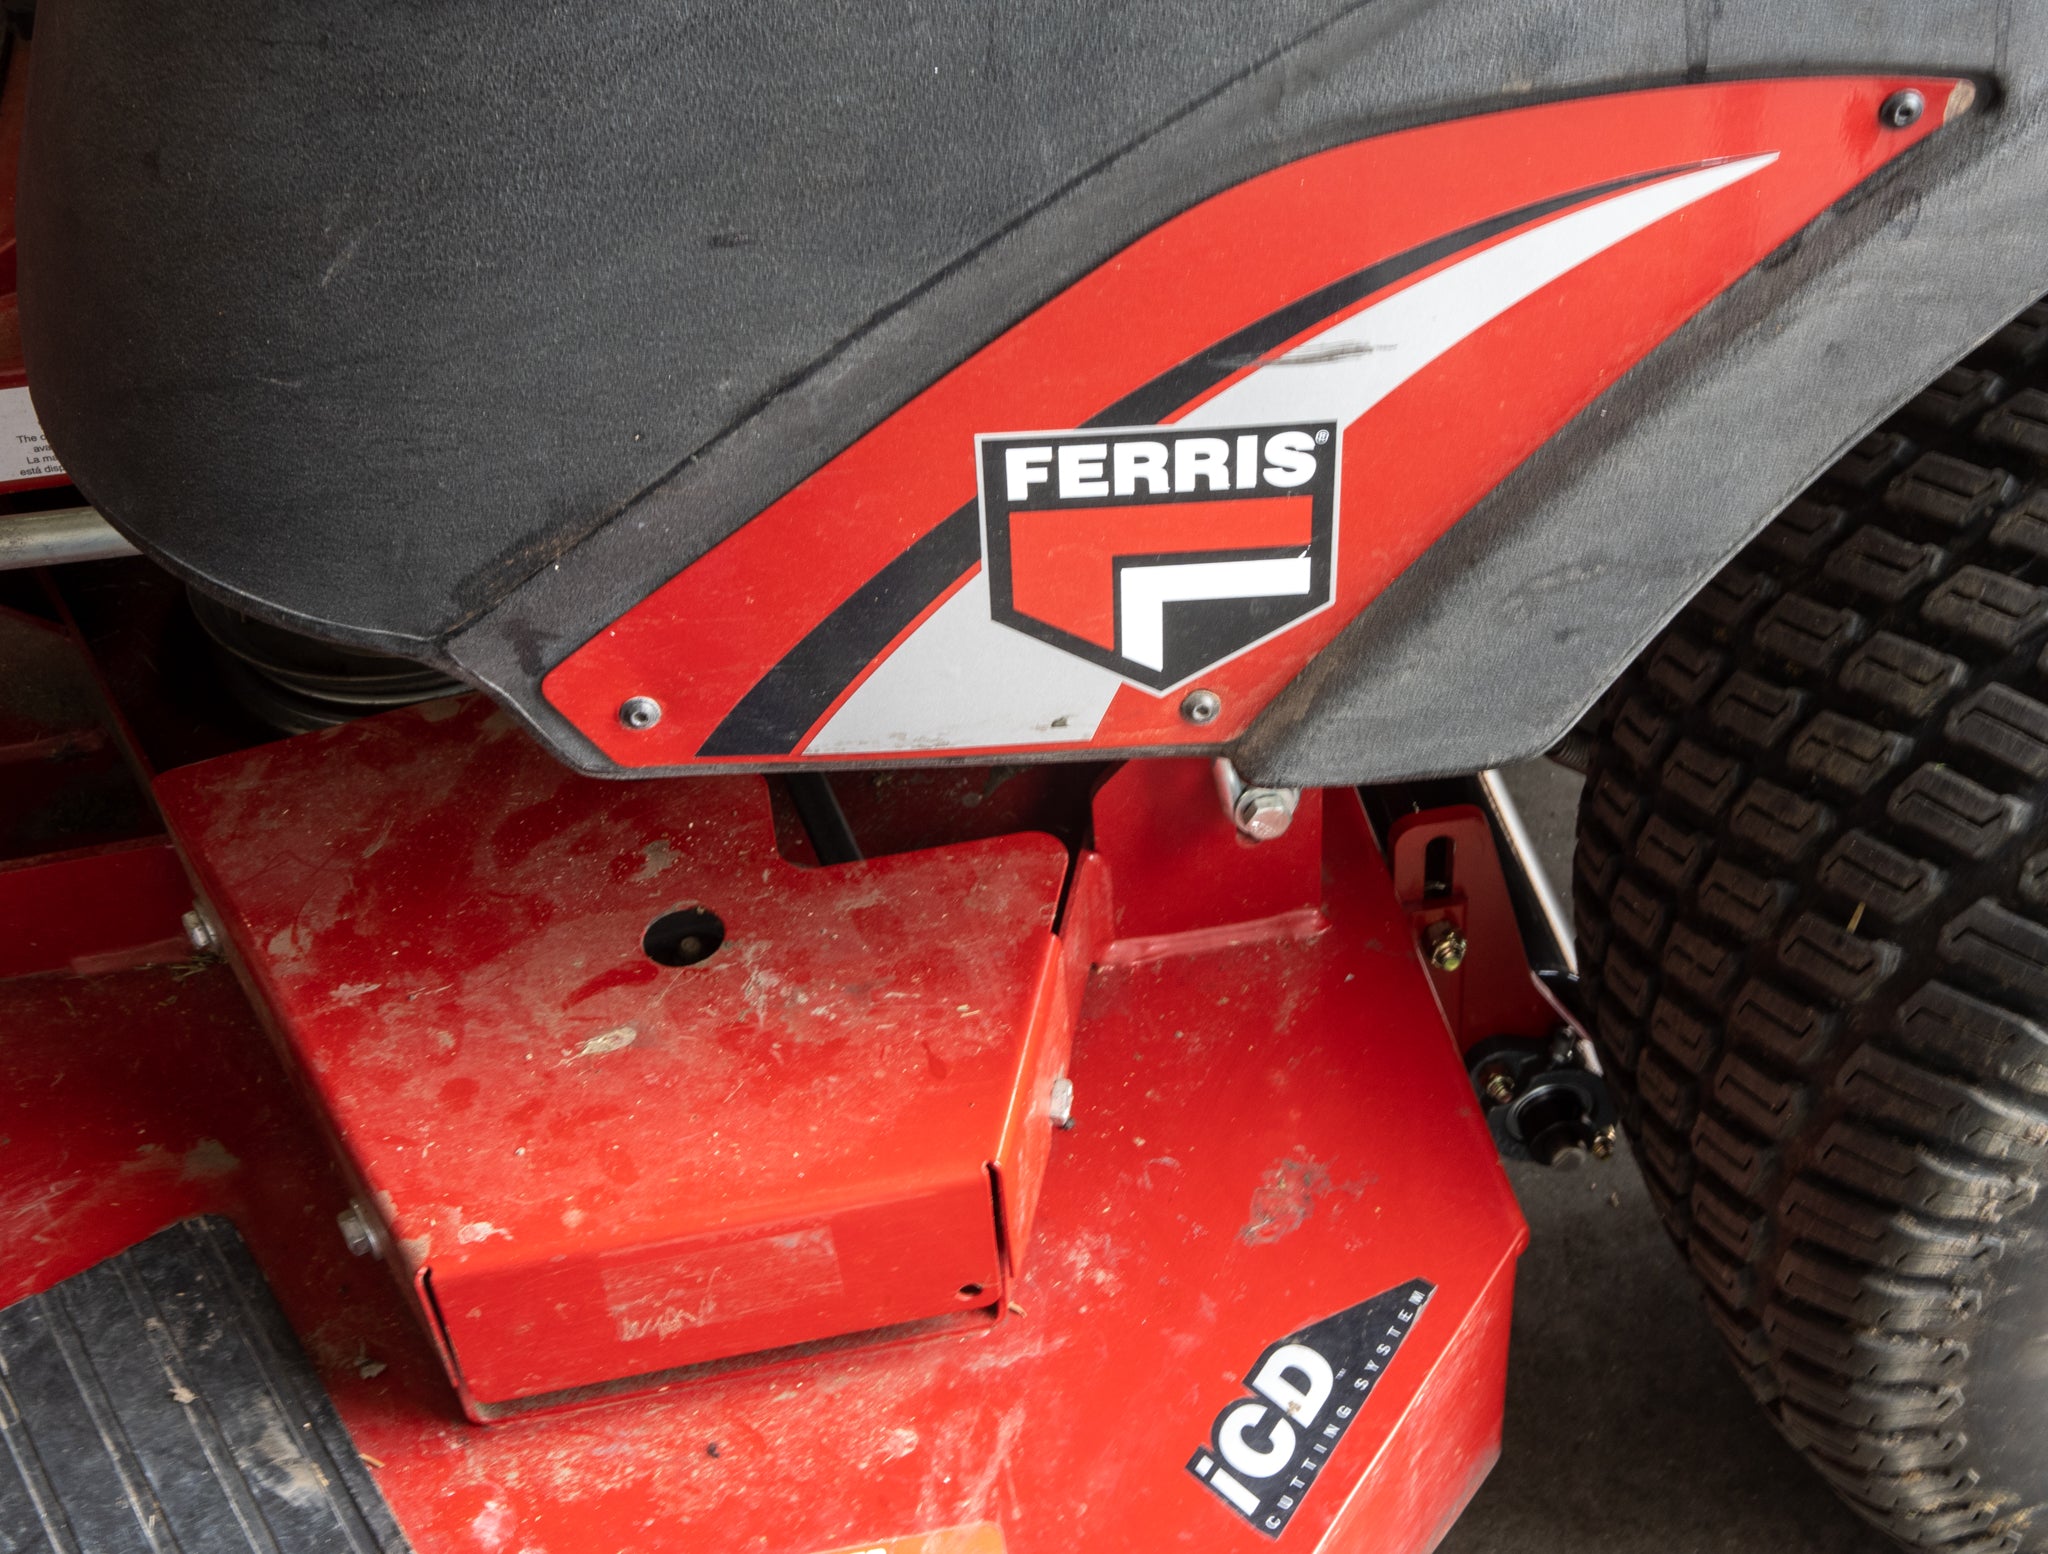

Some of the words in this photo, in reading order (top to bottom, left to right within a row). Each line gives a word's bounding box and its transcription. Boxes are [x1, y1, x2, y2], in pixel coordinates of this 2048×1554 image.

[16, 435, 37, 443] The
[20, 466, 42, 476] está
[1195, 1344, 1334, 1516] iCD
[1265, 1404, 1352, 1530] CUTTING
[1353, 1290, 1425, 1391] SYSTEM
